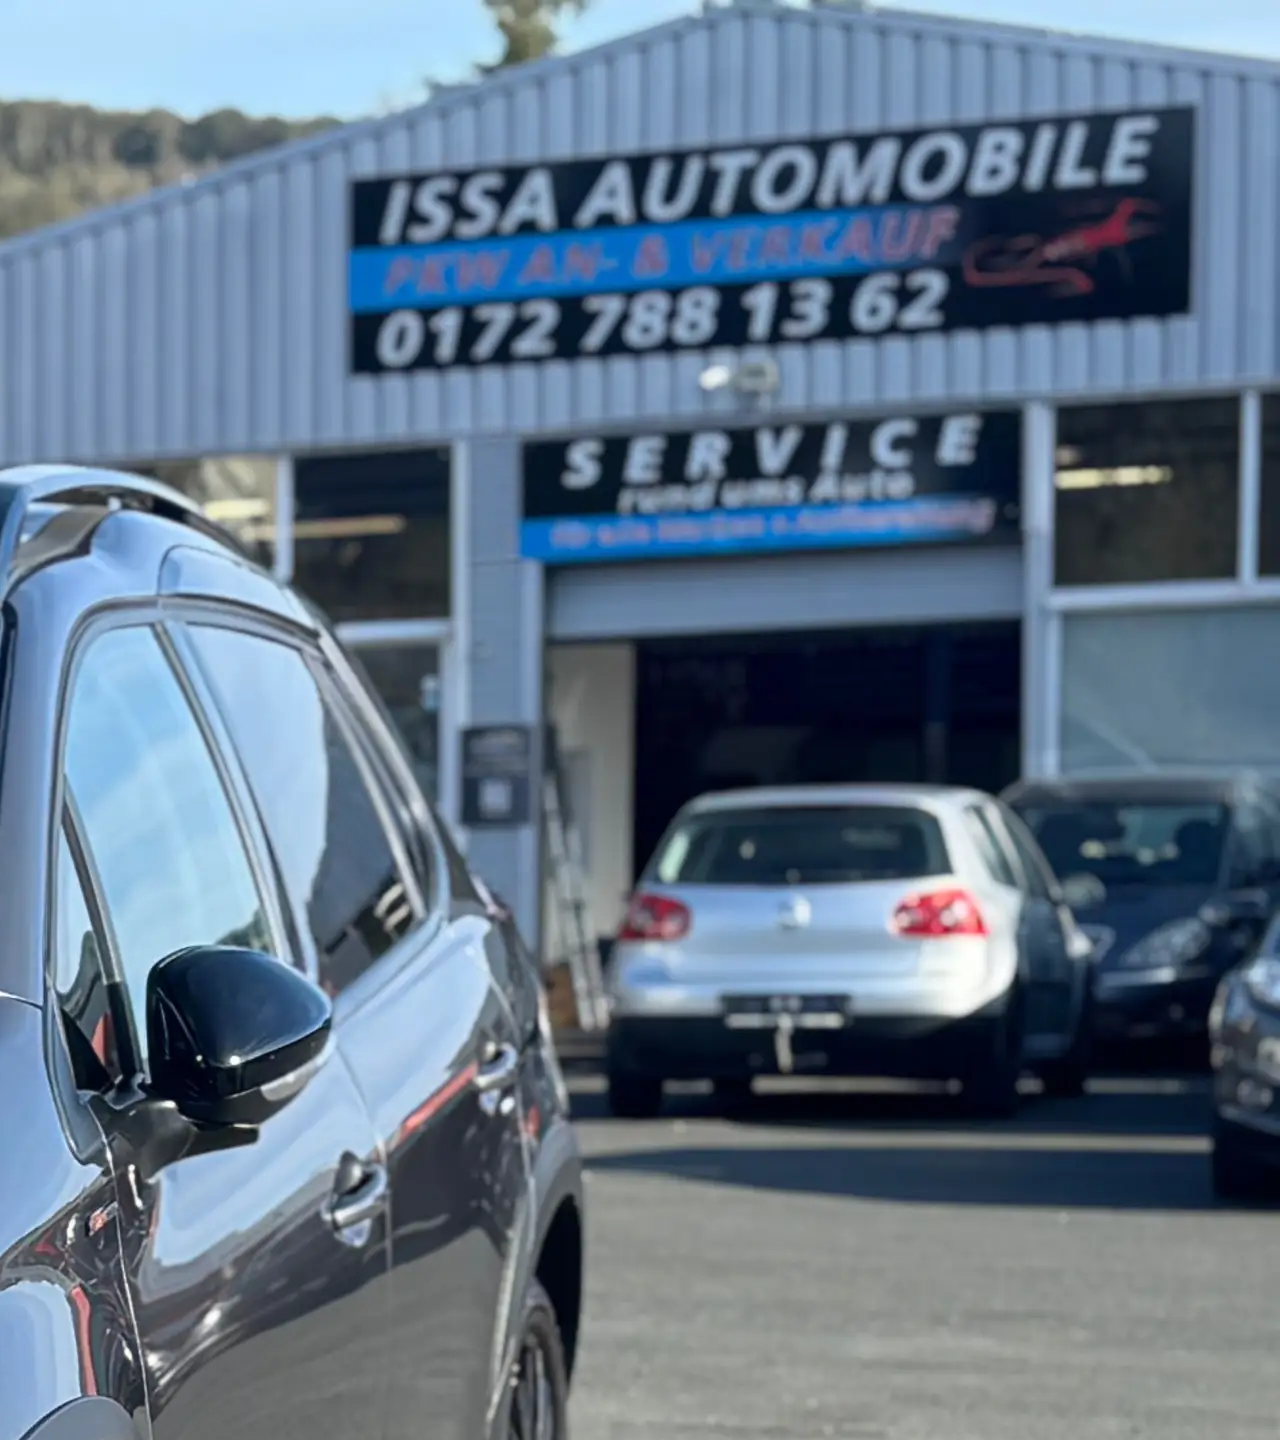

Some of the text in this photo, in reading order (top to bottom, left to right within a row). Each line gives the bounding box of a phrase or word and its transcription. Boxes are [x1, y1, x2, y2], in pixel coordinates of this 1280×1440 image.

[378, 115, 1160, 246] ISSA AUTOMOBILE
[374, 267, 950, 370] 0172 788 13 62
[561, 414, 983, 489] SERVICE
